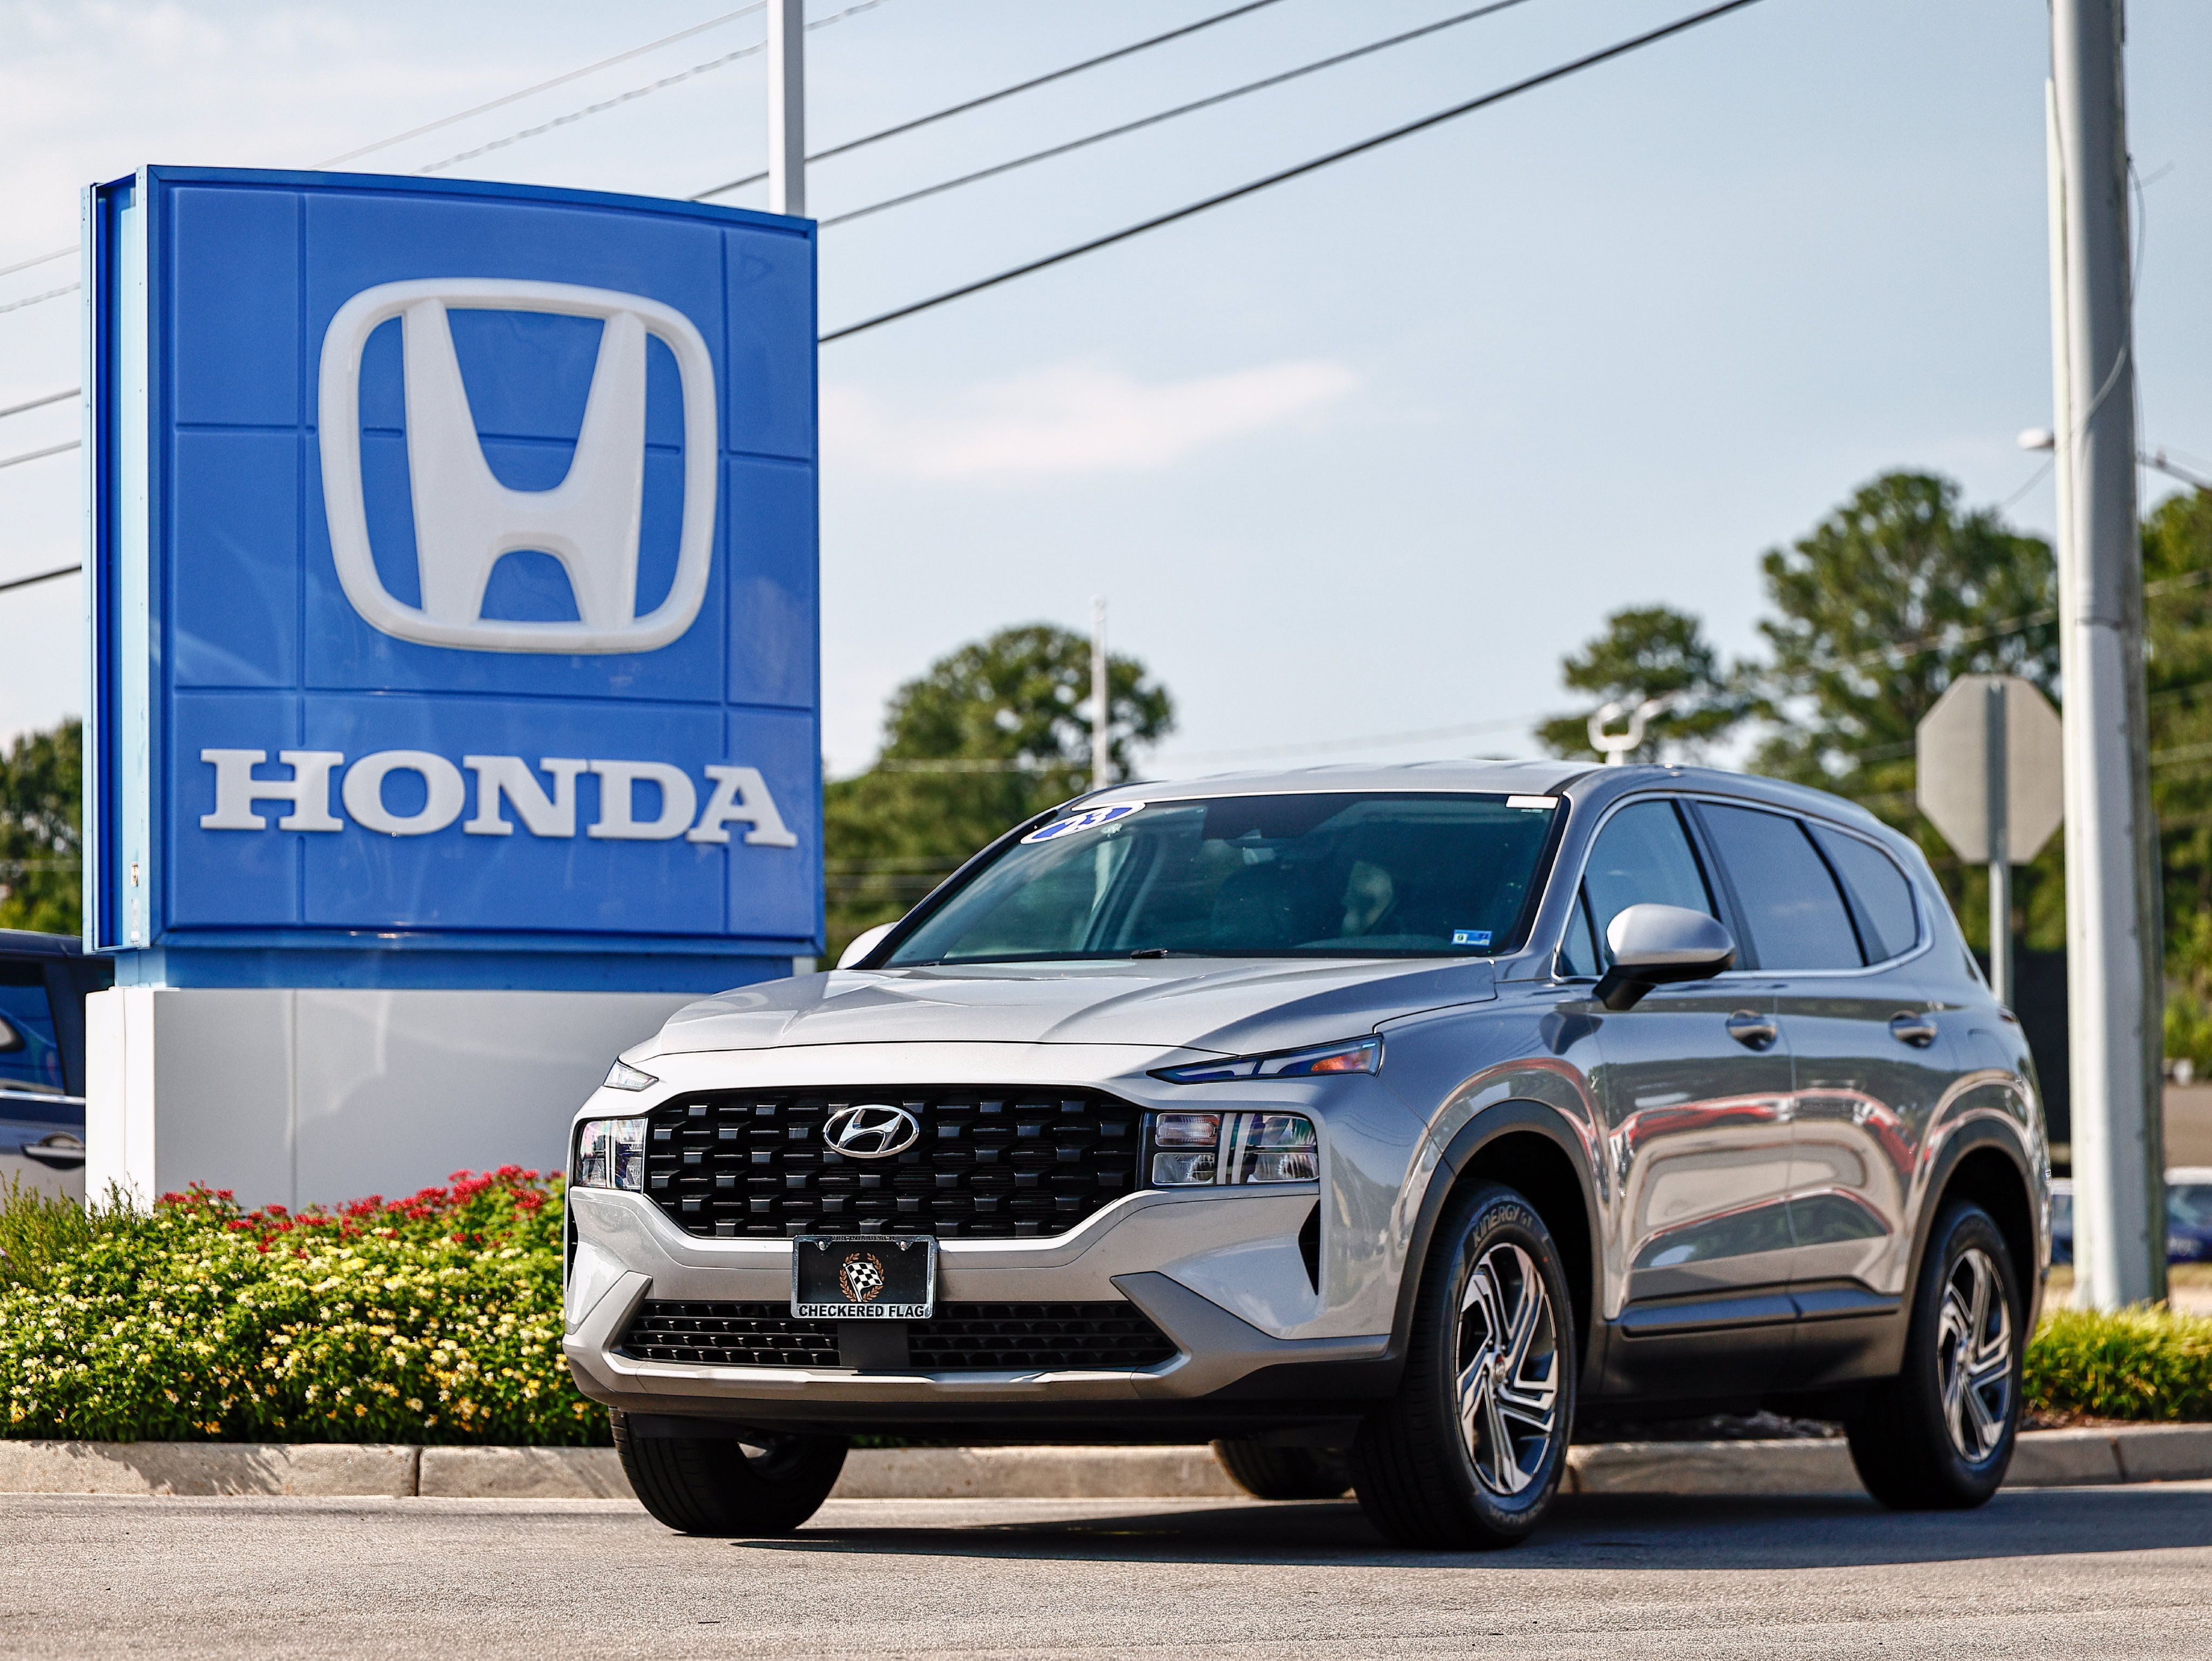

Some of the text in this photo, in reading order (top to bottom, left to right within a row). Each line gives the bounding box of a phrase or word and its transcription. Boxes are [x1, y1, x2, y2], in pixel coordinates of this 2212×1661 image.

[200, 748, 798, 847] HONDA
[1473, 1205, 1521, 1248] KINERGY
[799, 1305, 924, 1317] CHECKERED FLAG
